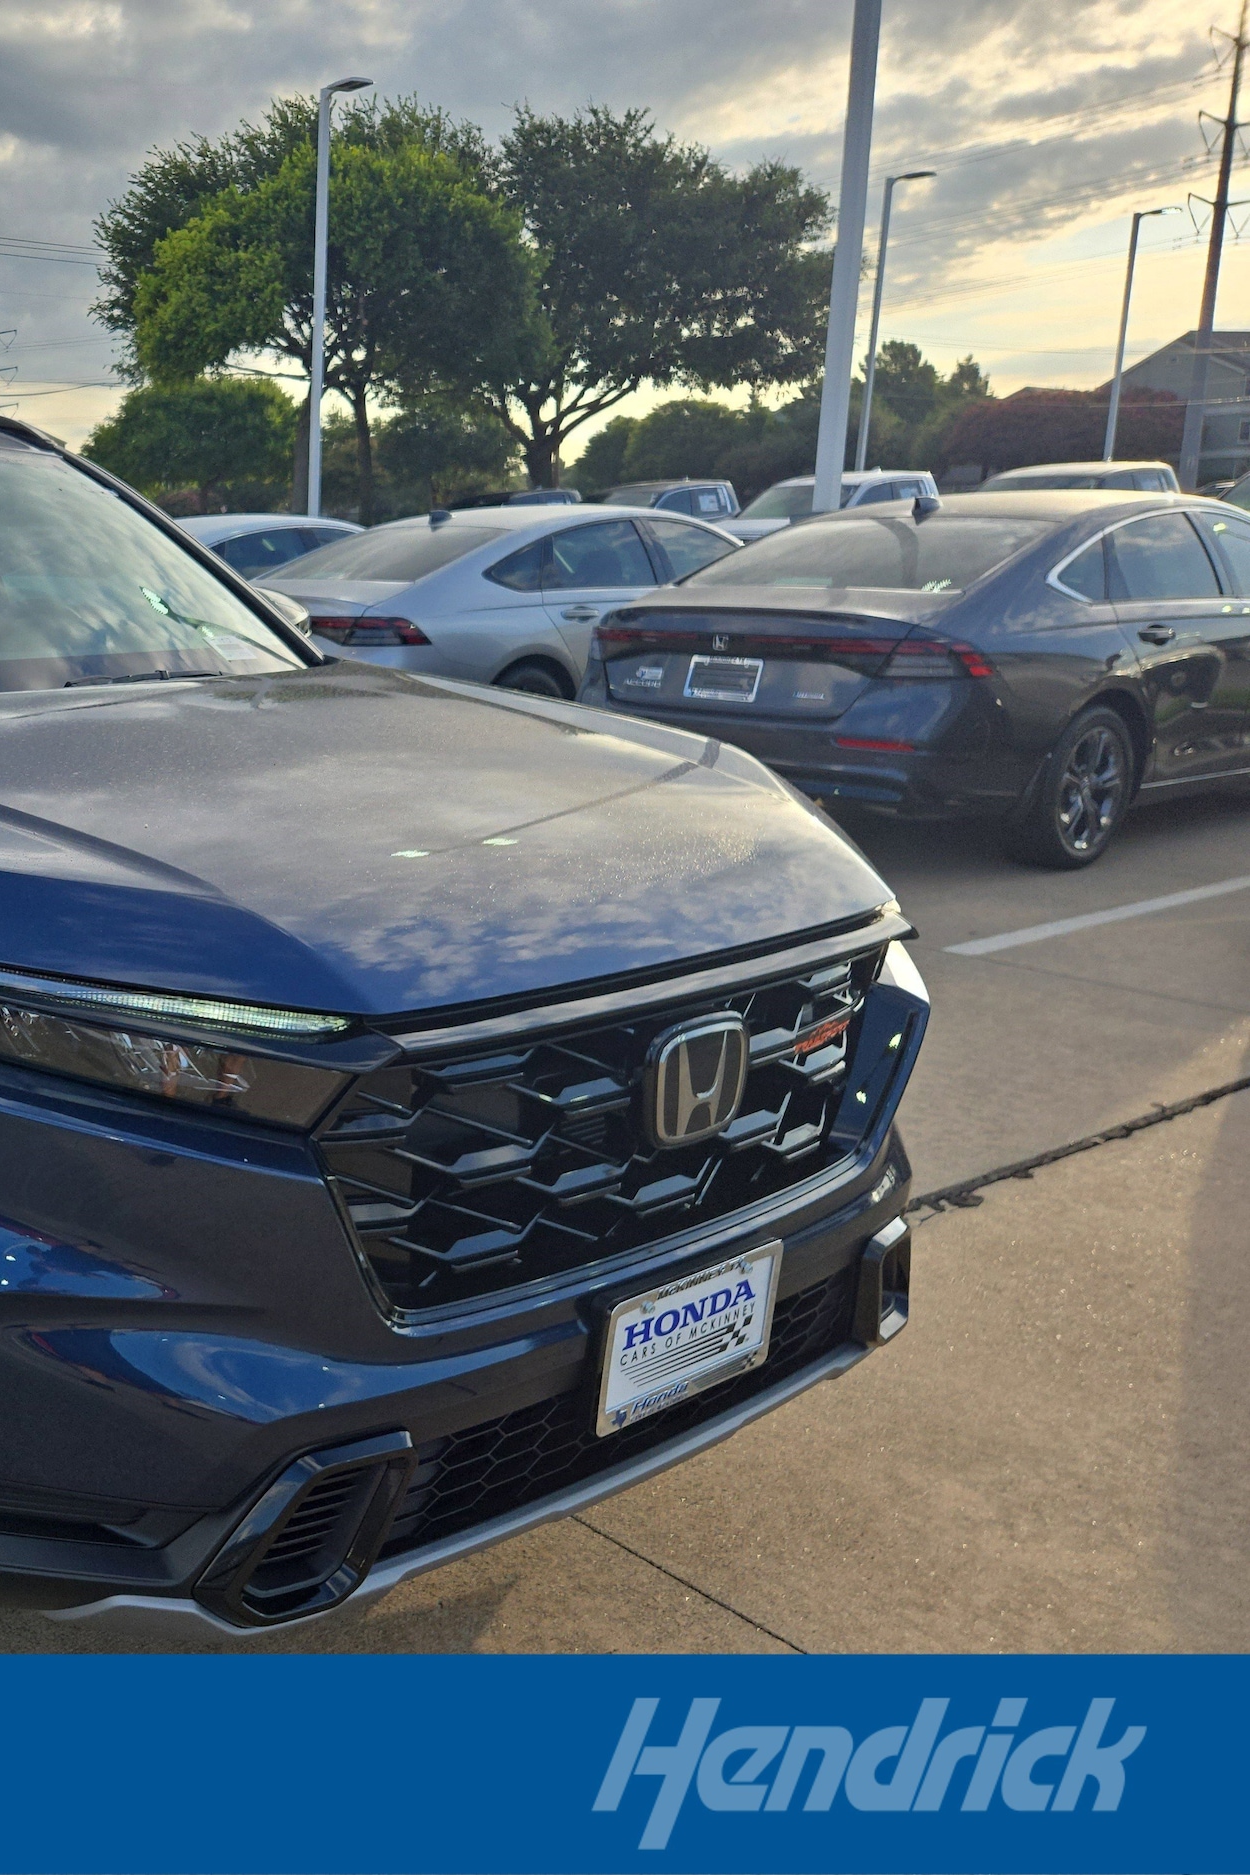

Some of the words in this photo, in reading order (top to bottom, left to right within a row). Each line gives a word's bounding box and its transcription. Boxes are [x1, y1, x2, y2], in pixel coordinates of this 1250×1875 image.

[620, 1342, 657, 1366] CARS
[665, 1334, 682, 1348] OF
[688, 1302, 756, 1341] MCKINNEY
[622, 1279, 756, 1351] HONDA
